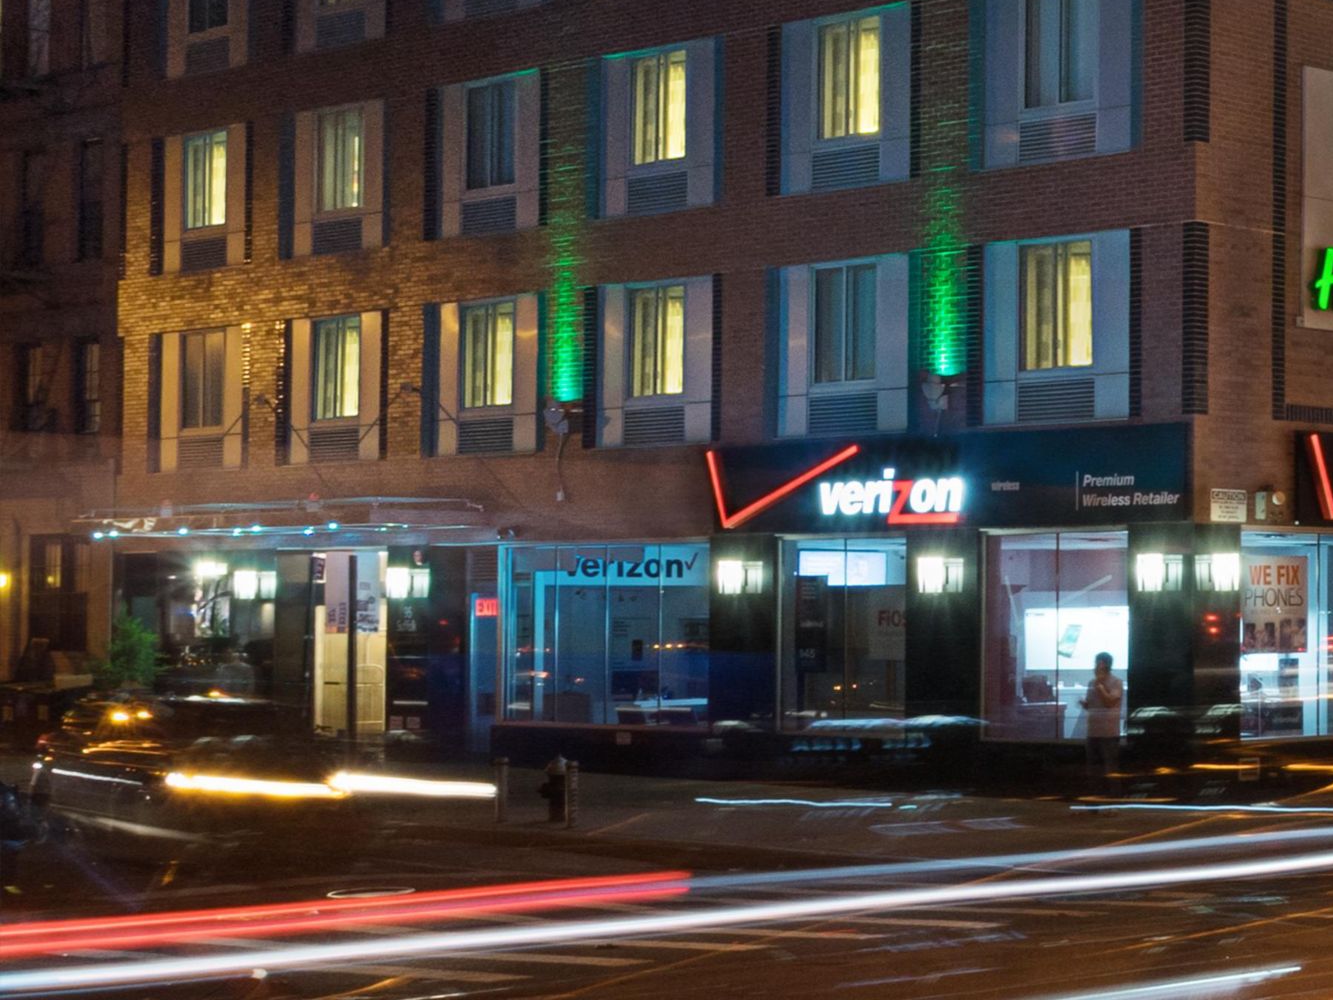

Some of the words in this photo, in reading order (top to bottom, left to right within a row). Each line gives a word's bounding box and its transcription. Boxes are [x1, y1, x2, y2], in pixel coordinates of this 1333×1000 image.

[1083, 474, 1135, 487] Premium
[819, 467, 964, 524] verizon
[1083, 493, 1131, 507] Wireless
[1133, 491, 1180, 506] Retailer
[1249, 565, 1272, 585] WE
[1277, 565, 1300, 585] FIX
[1243, 588, 1304, 607] PHONES
